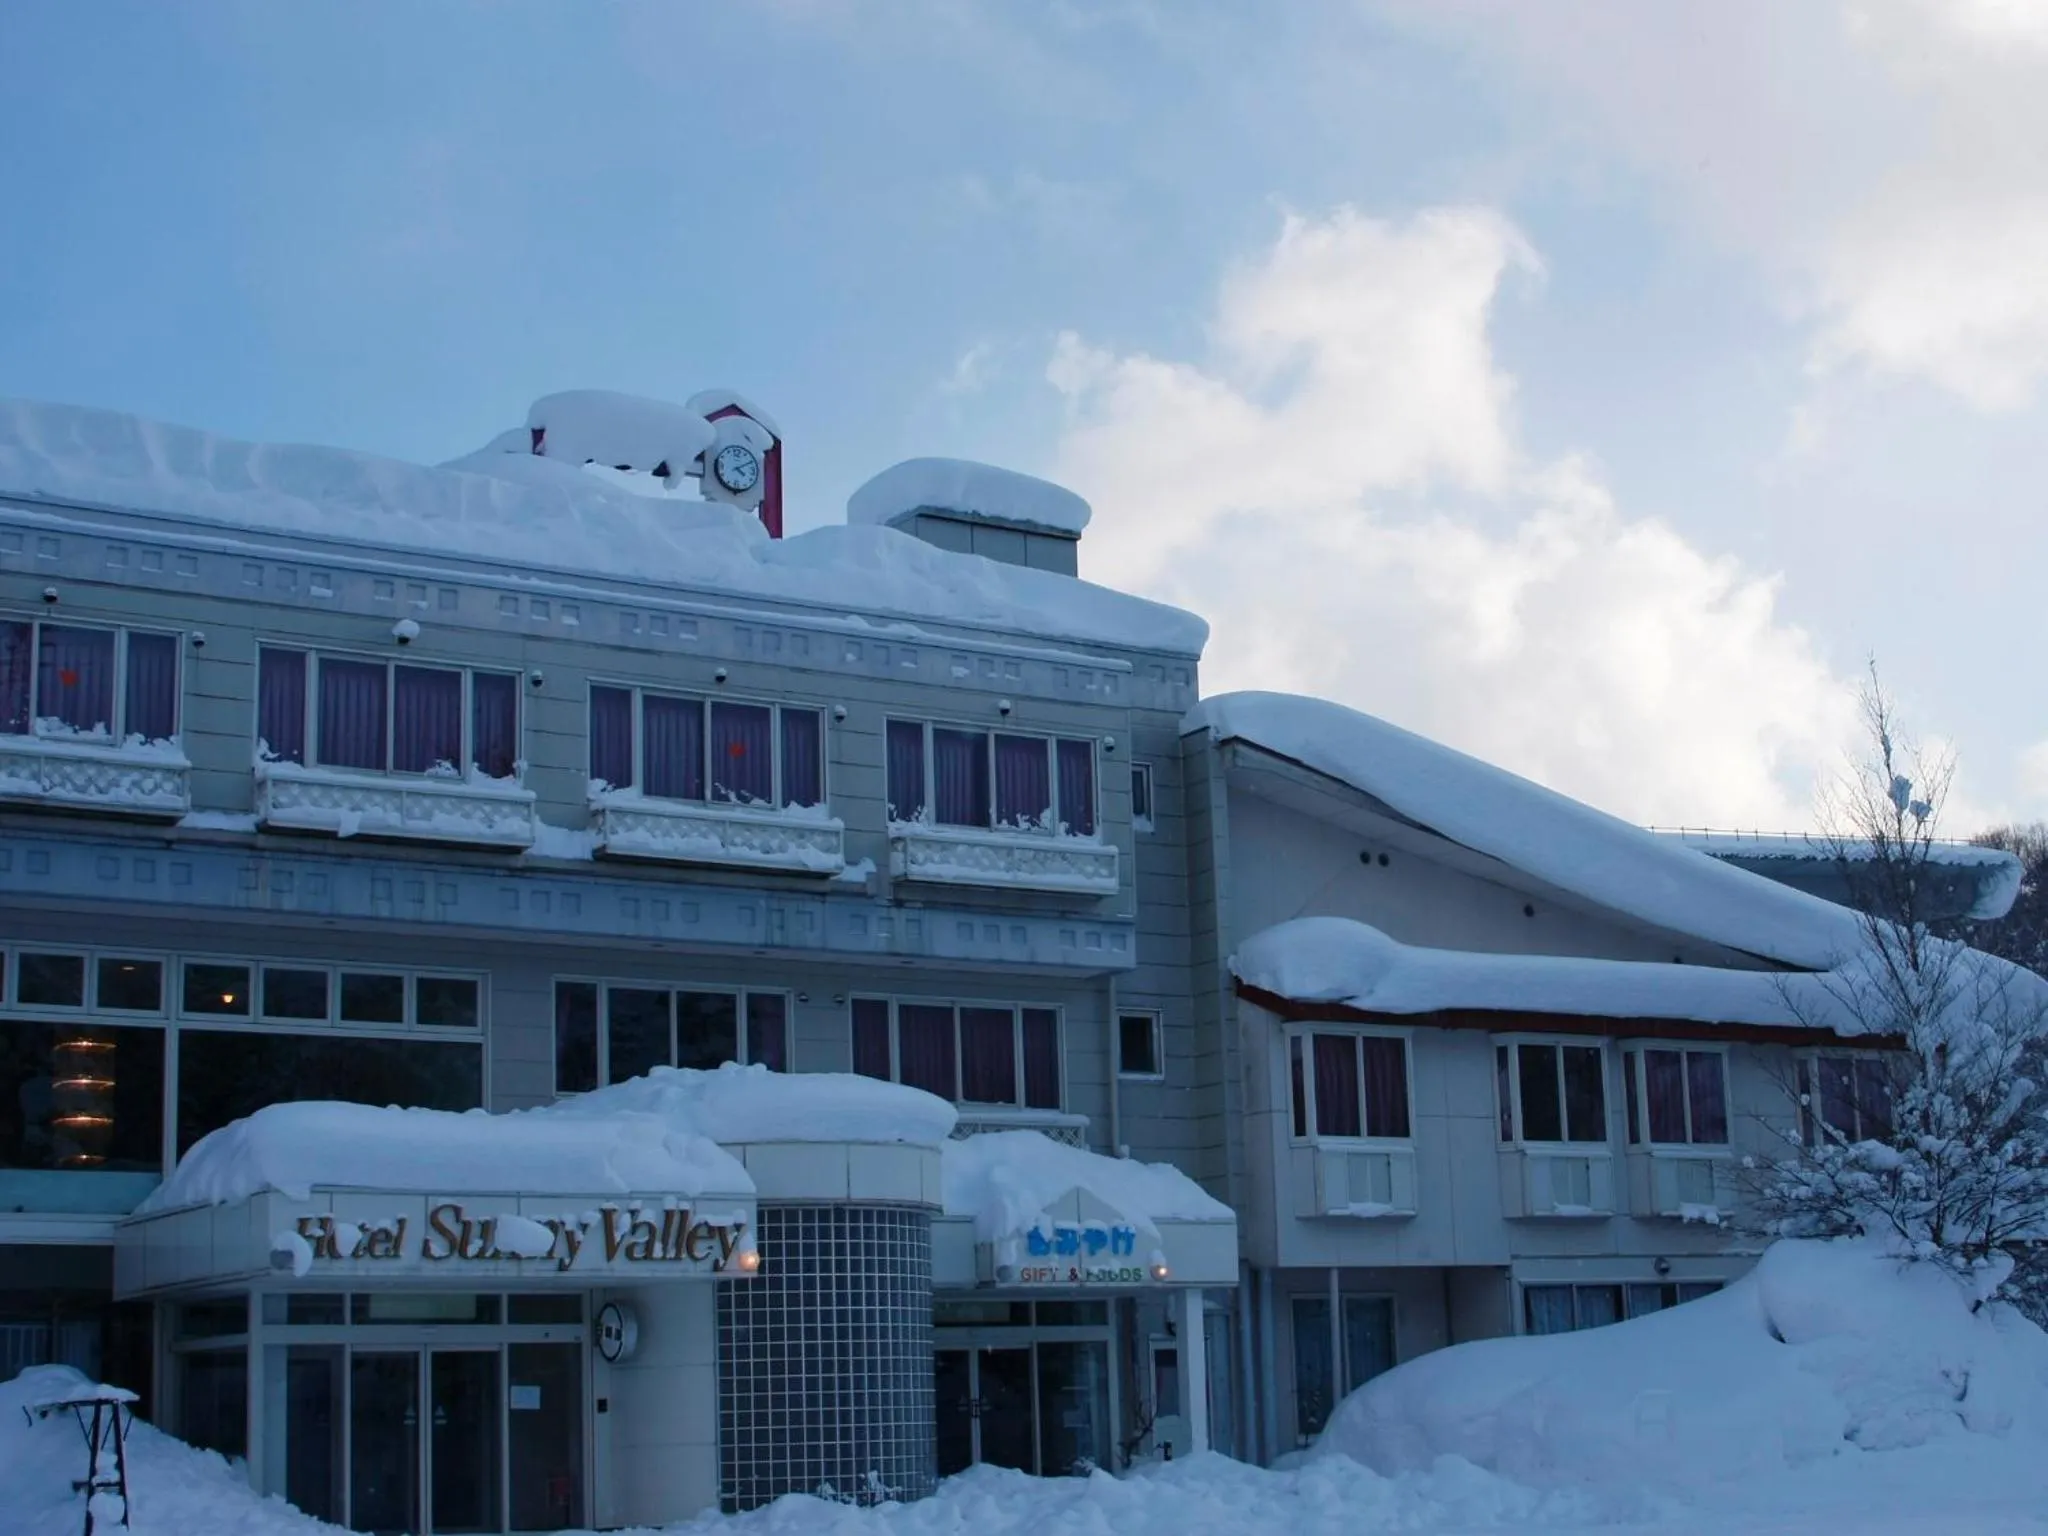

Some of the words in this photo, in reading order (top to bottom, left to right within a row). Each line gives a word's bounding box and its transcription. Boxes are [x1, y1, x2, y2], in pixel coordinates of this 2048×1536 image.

[599, 1206, 746, 1271] Valley
[1021, 1267, 1058, 1282] GIFT
[1069, 1266, 1079, 1282] &
